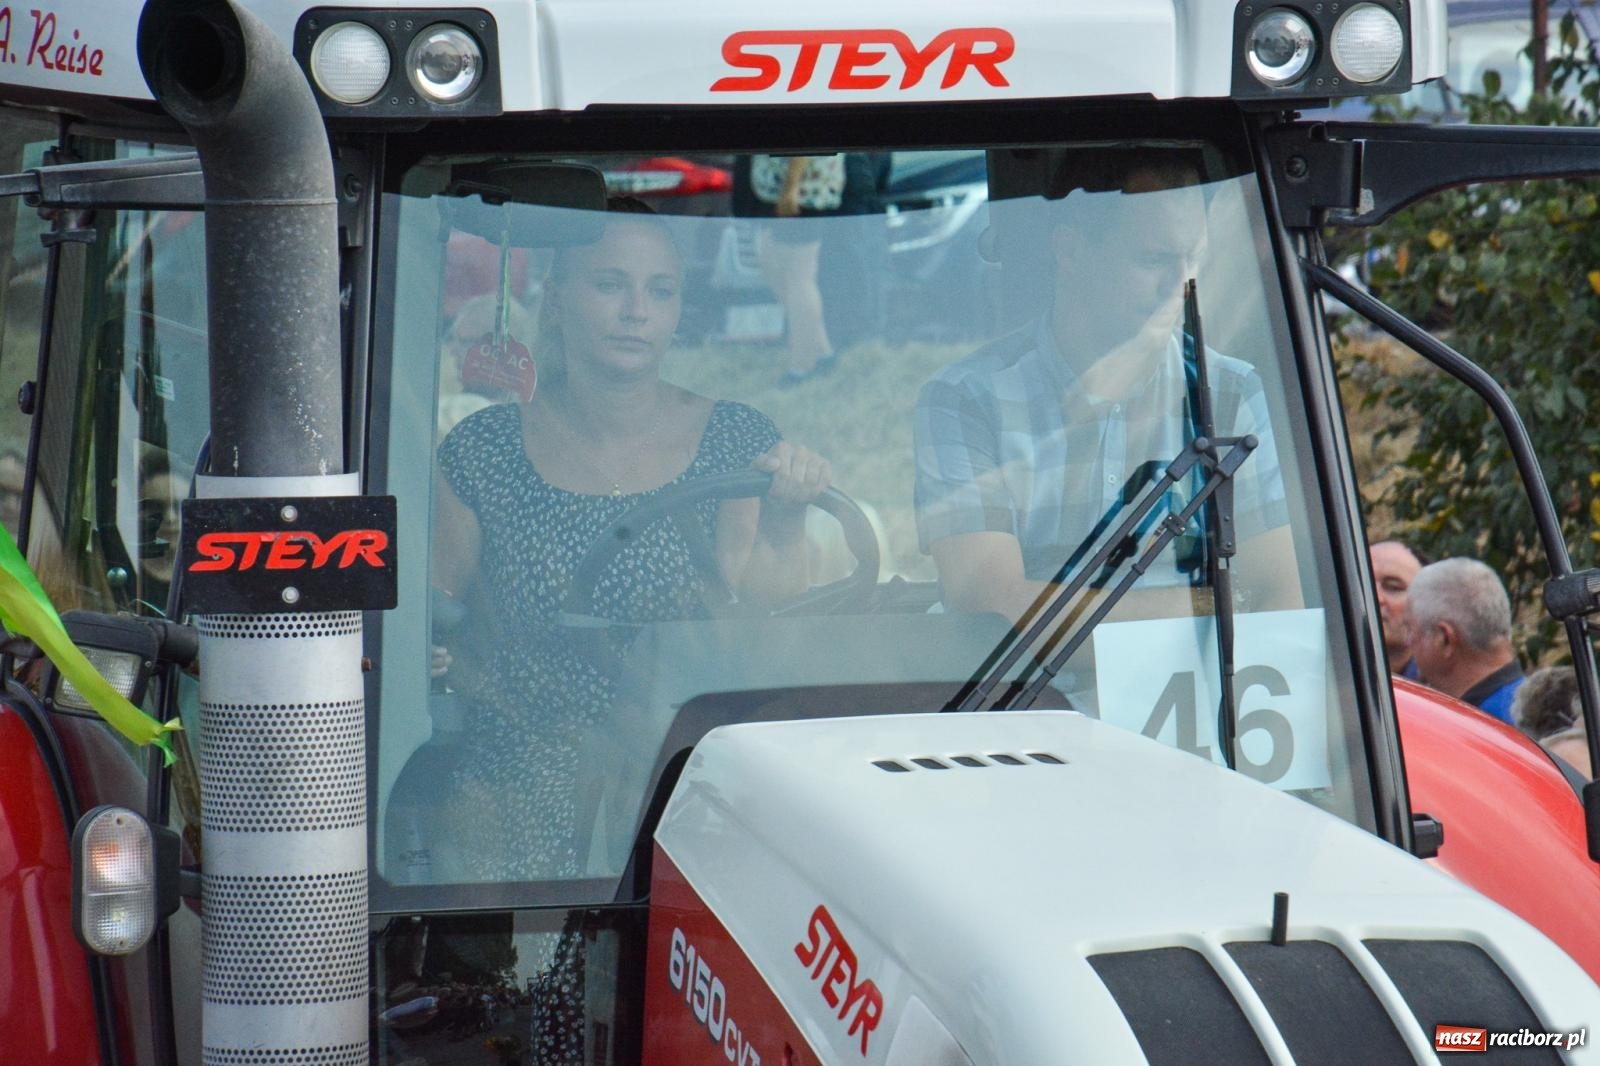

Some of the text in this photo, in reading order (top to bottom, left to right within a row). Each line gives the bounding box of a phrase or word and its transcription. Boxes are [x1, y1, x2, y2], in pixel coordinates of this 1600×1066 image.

[26, 9, 104, 76] Reise
[709, 27, 1015, 92] STEYR
[187, 529, 388, 572] STEYR
[1140, 664, 1295, 784] 46
[668, 927, 726, 1042] 6150
[794, 904, 884, 1057] STEYR
